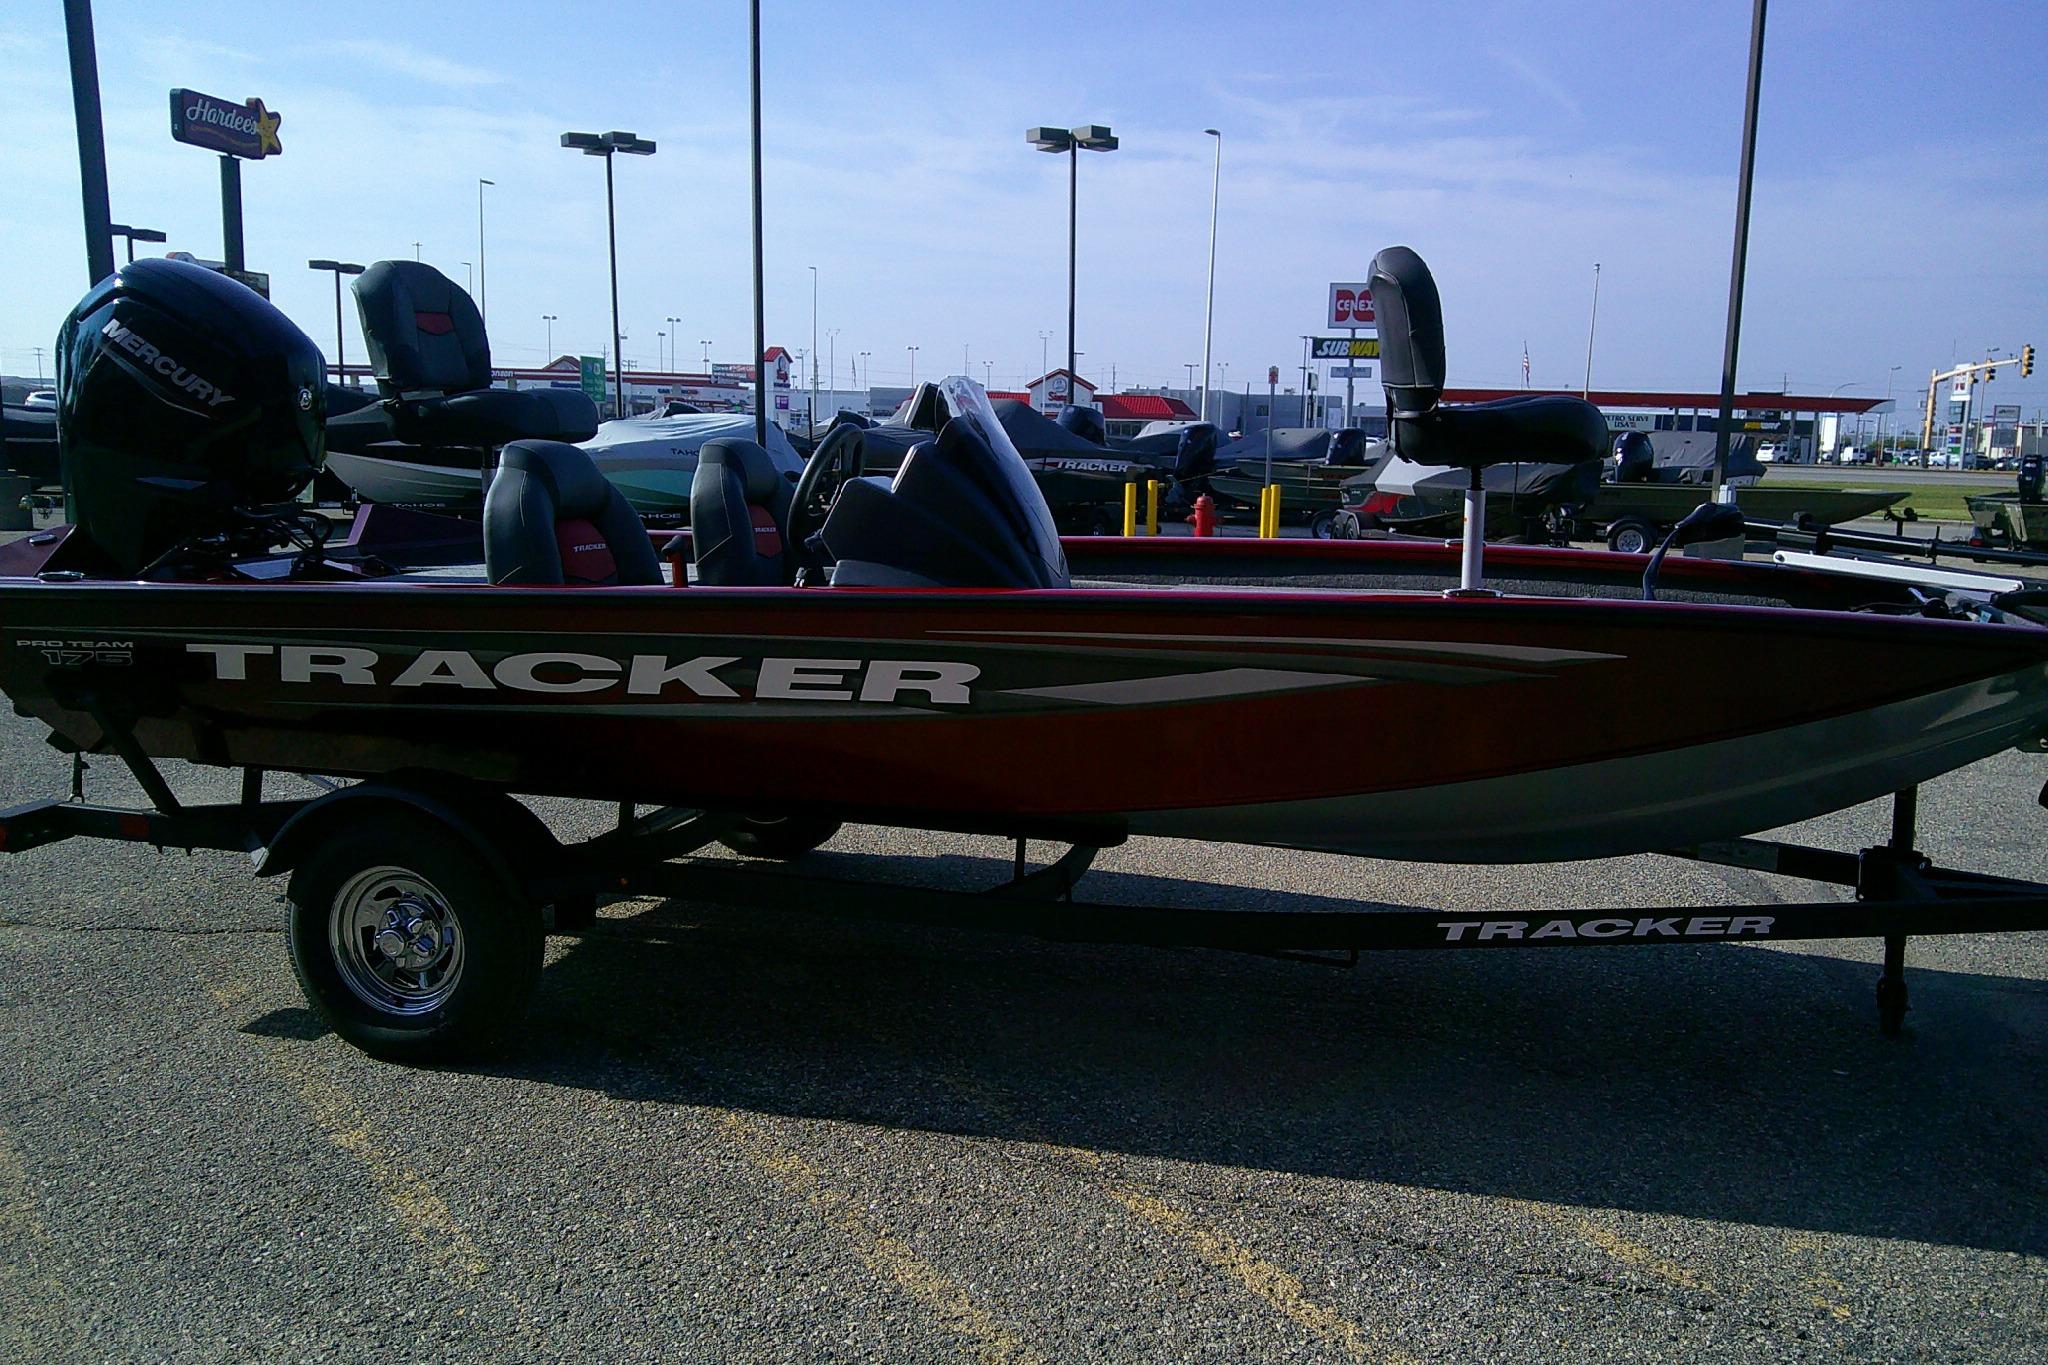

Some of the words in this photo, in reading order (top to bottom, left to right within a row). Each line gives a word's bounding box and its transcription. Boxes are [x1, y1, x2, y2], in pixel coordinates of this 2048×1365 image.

[186, 98, 258, 135] Hardee's
[102, 318, 236, 407] MERCURY
[670, 447, 699, 457] TAHO
[1056, 461, 1129, 473] TRACKER
[572, 543, 606, 552] TRACKER
[16, 639, 63, 647] PRO
[66, 640, 134, 648] TEAM
[41, 649, 133, 666] 175
[184, 642, 982, 705] TRACKER
[1436, 914, 1776, 942] TRACKER
